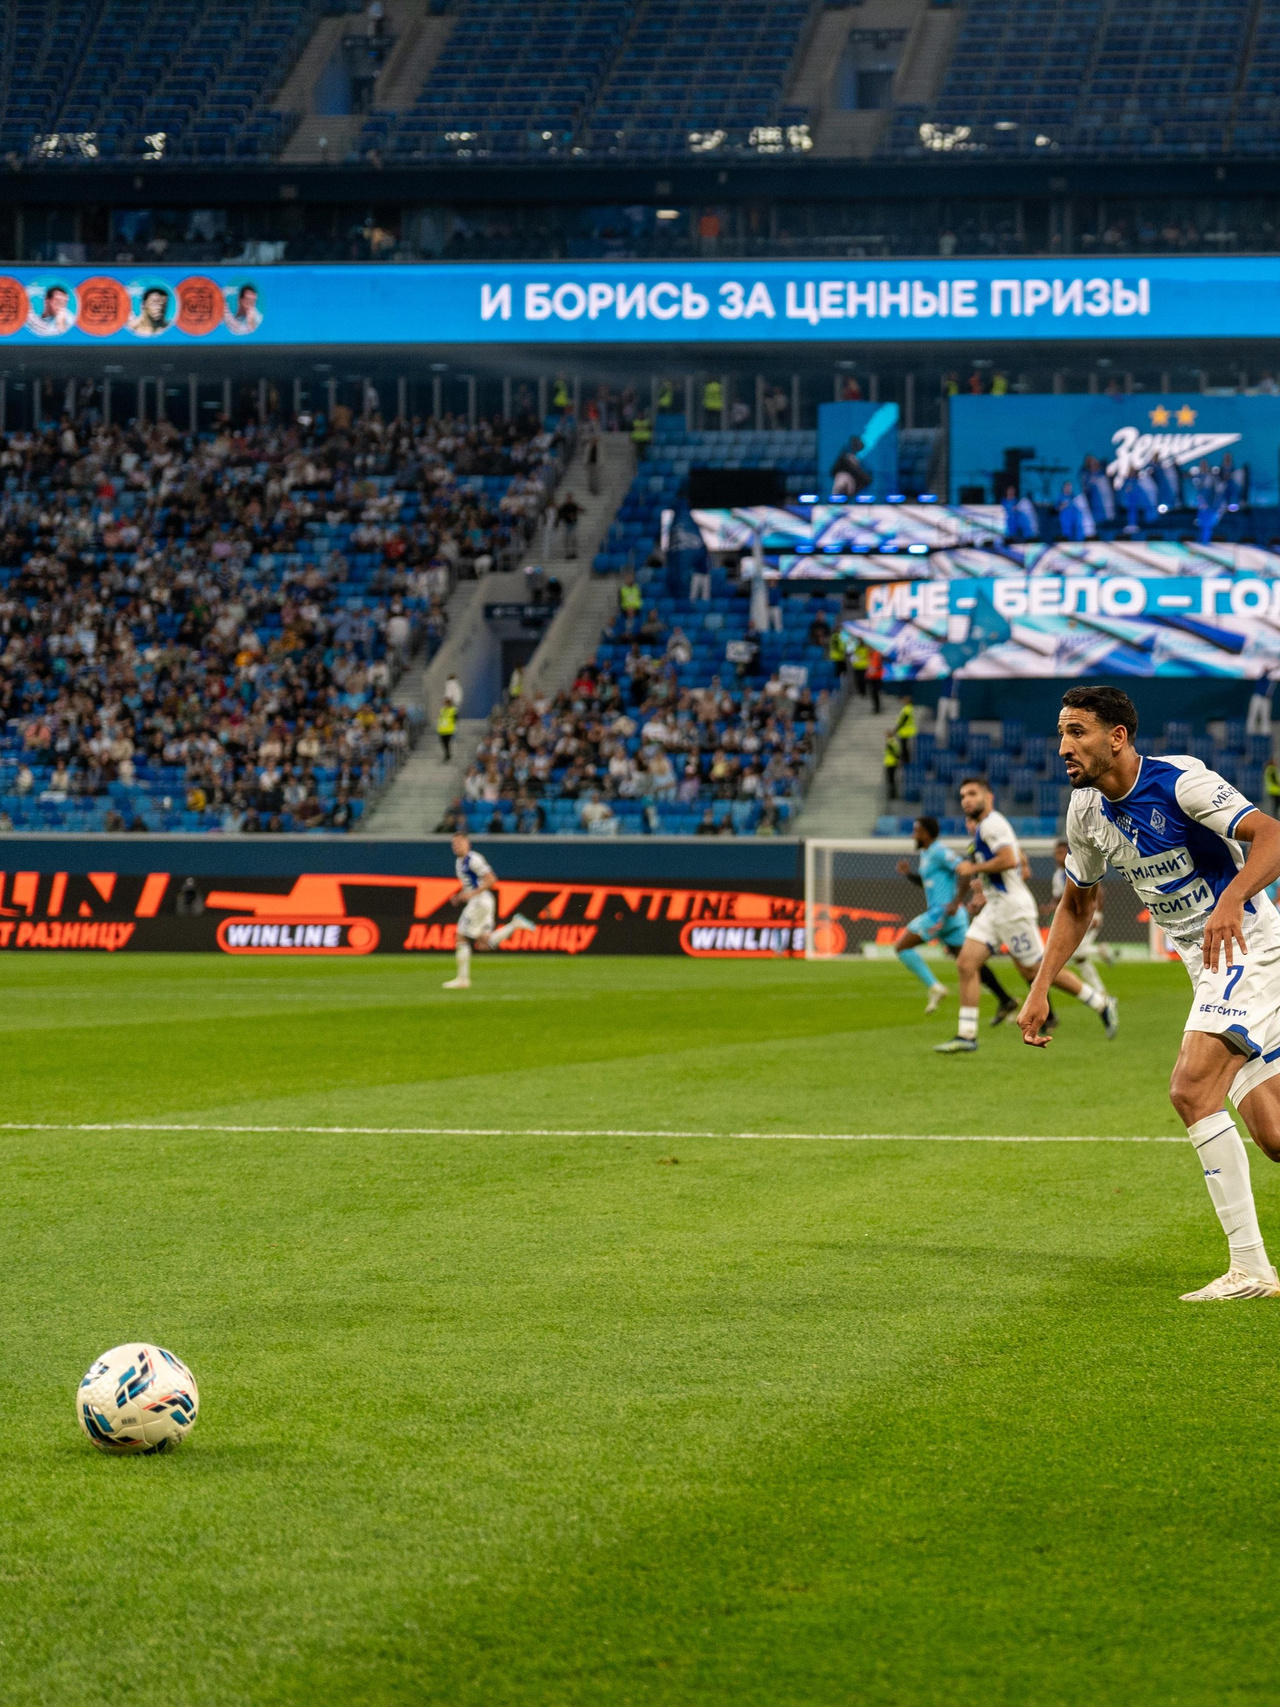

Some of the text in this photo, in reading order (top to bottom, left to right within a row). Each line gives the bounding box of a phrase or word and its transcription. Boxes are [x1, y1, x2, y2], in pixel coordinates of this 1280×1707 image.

[481, 278, 1150, 326] И БОРИСЬ ЗА ЦЕННЫЕ ПРИЗЫ
[993, 577, 1148, 617] БЕЛО
[1131, 852, 1188, 880] МАГНИТ
[1144, 884, 1209, 916] ЕТСИТИ
[16, 921, 136, 952] РАЗНИЦУ
[228, 924, 342, 947] WINLINE
[404, 923, 458, 950] ЛАЕ
[1222, 964, 1245, 1001] 7
